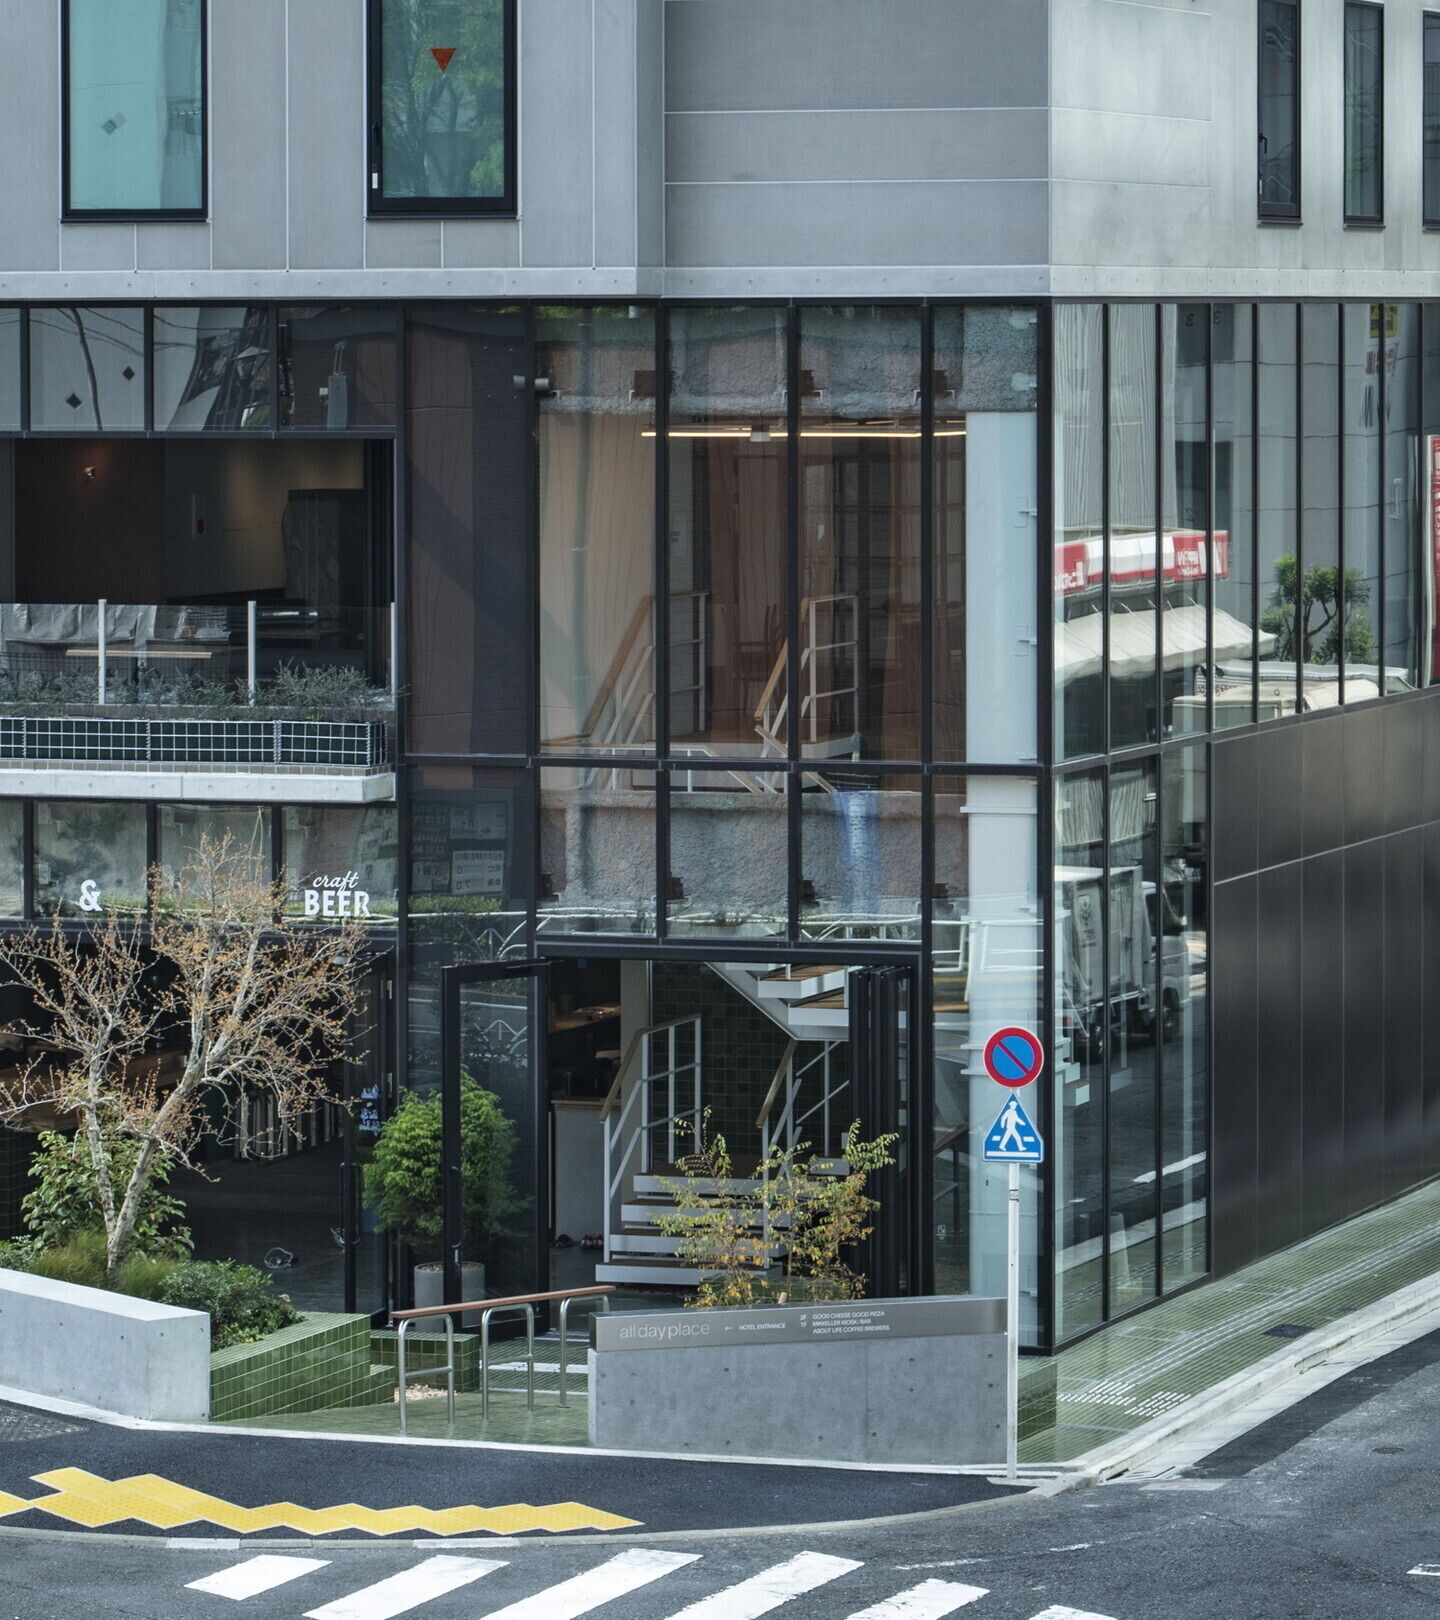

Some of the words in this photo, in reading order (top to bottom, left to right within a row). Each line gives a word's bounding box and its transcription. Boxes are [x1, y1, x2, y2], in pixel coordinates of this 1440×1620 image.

[312, 870, 360, 896] craft
[79, 879, 104, 912] &
[304, 889, 371, 917] BEER
[800, 1313, 807, 1321] 2F
[812, 1312, 830, 1320] GOOD
[830, 1311, 851, 1319] CHEESE
[756, 1323, 786, 1331] ENTRANCE
[812, 1327, 832, 1335] ABOUT
[832, 1326, 842, 1334] LIFE
[843, 1325, 864, 1333] COFFEE
[864, 1324, 890, 1332] BREWERS
